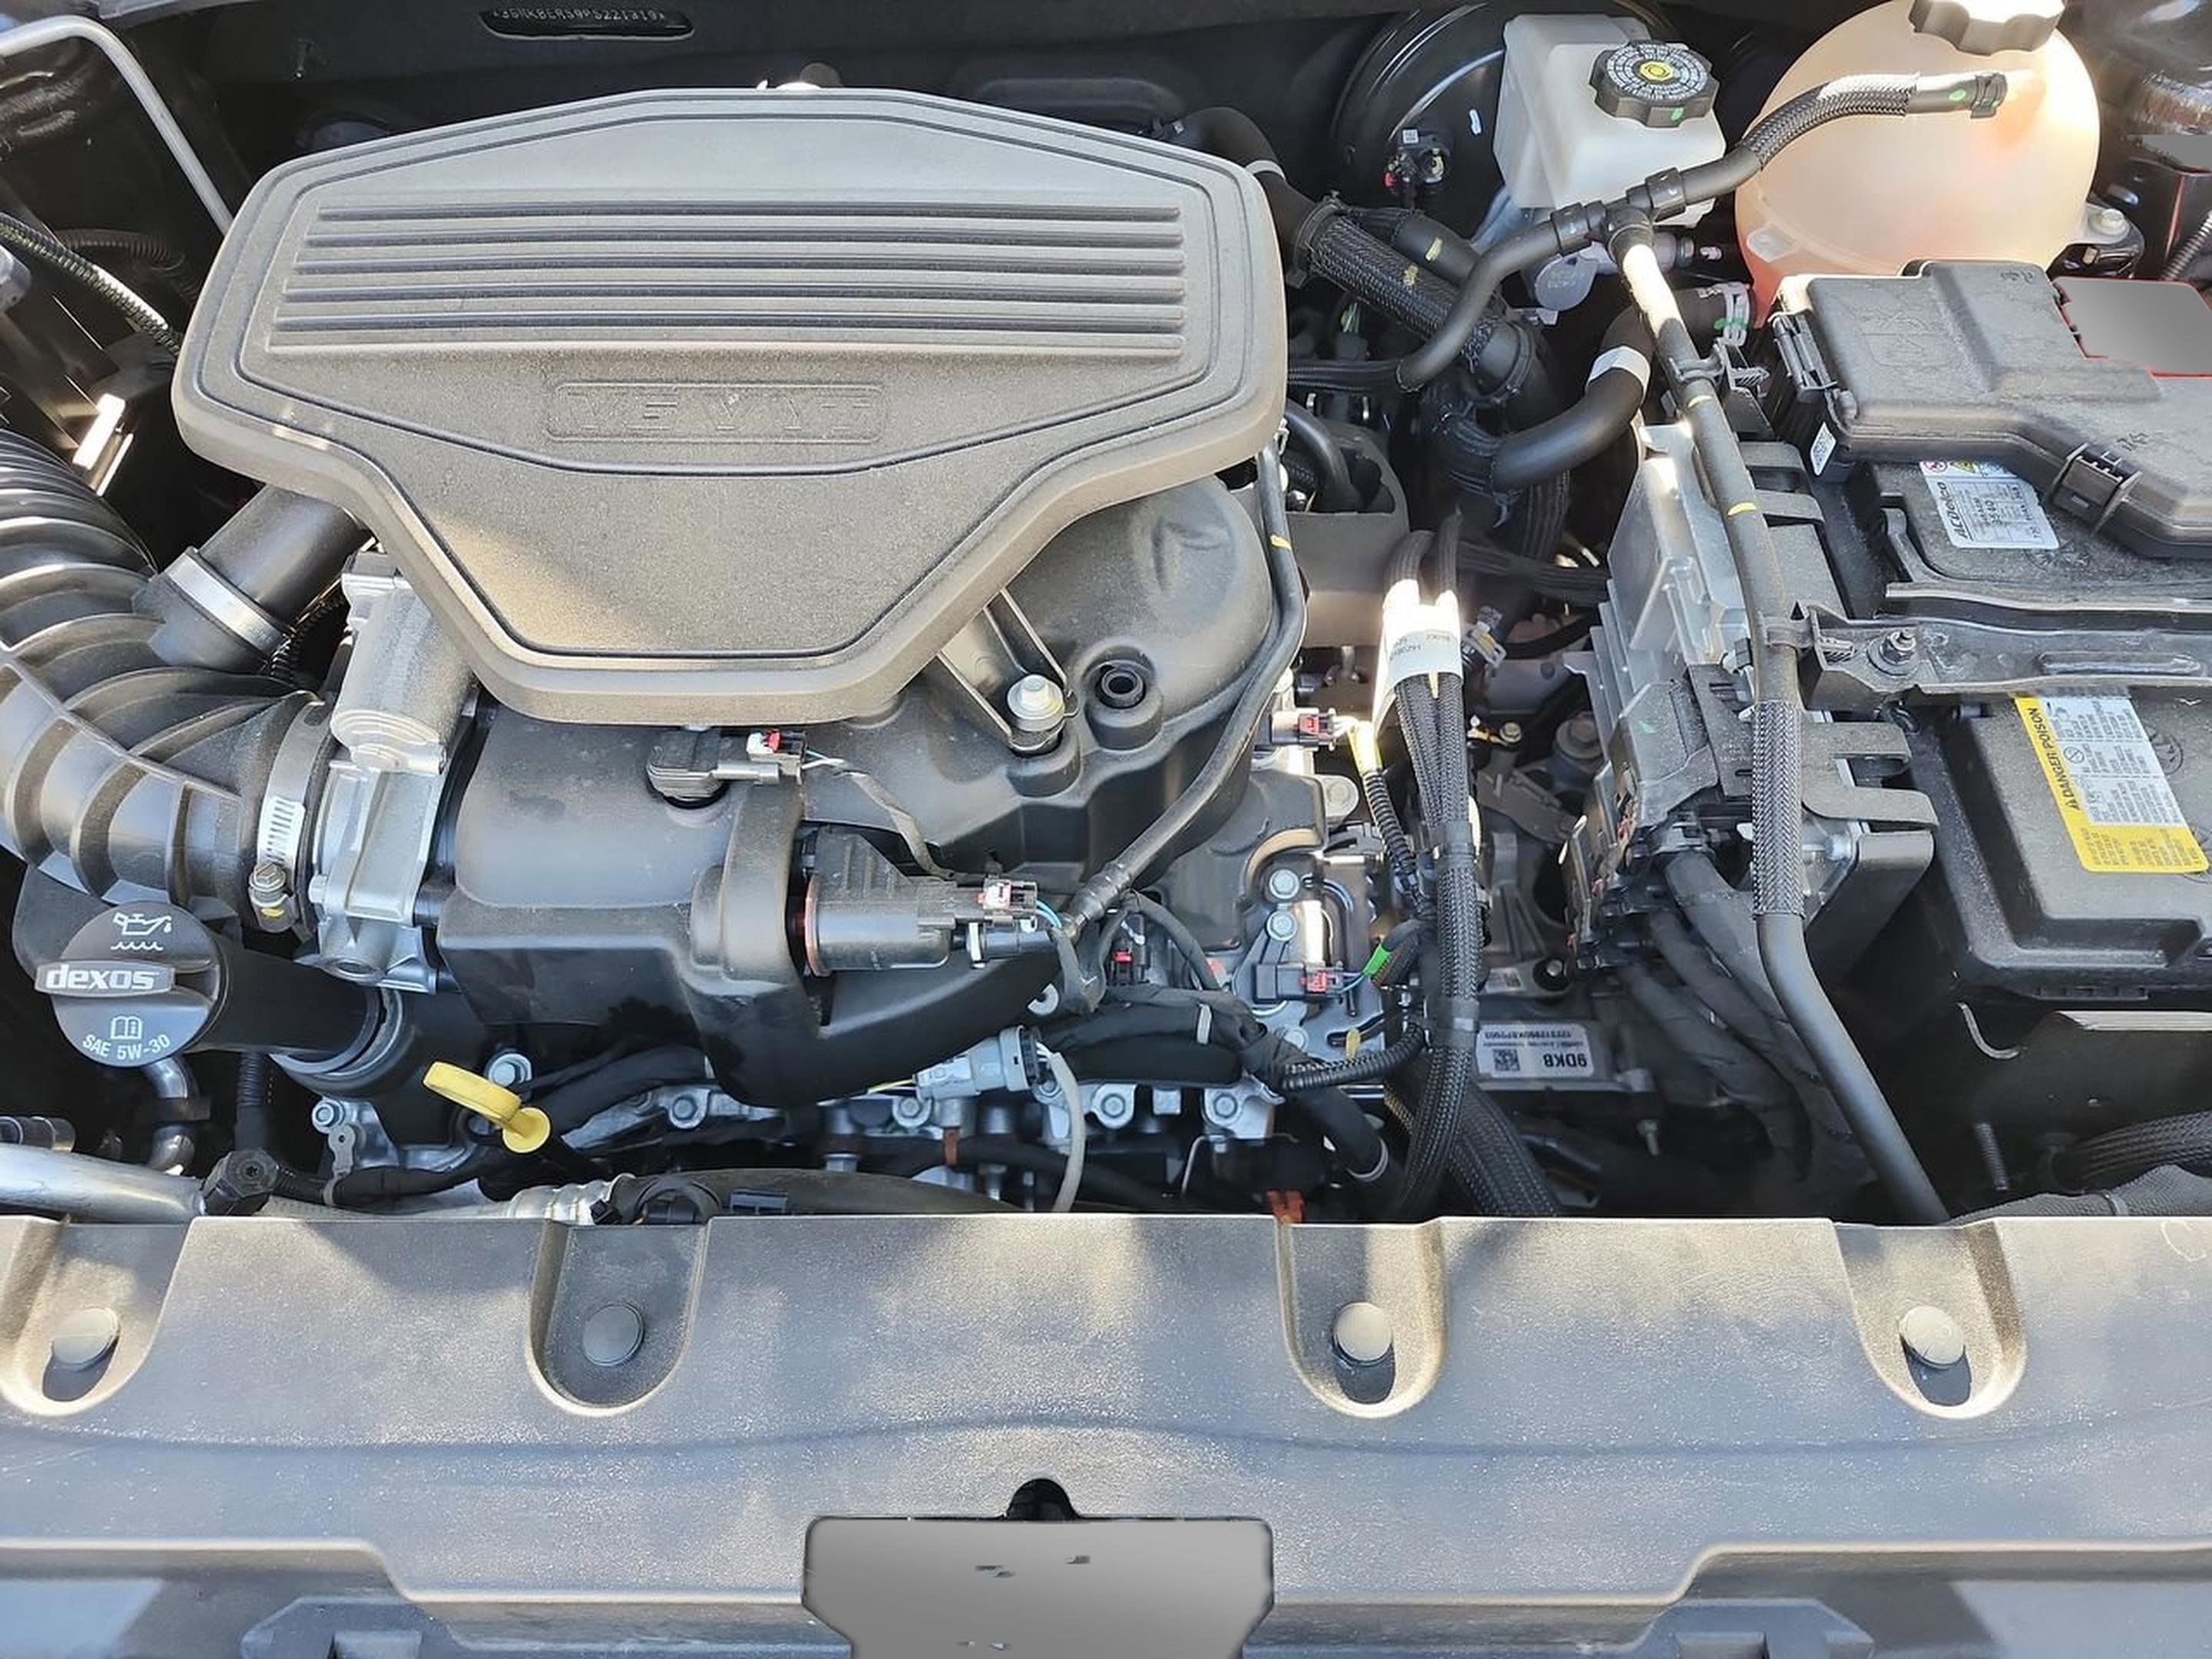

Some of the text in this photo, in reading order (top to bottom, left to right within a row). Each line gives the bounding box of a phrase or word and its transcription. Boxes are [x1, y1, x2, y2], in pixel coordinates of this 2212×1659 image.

[1937, 481, 1968, 539] ACDelco
[2028, 707, 2053, 750] POISON
[45, 964, 159, 990] dexos
[82, 1034, 171, 1061] SAE 5W-30
